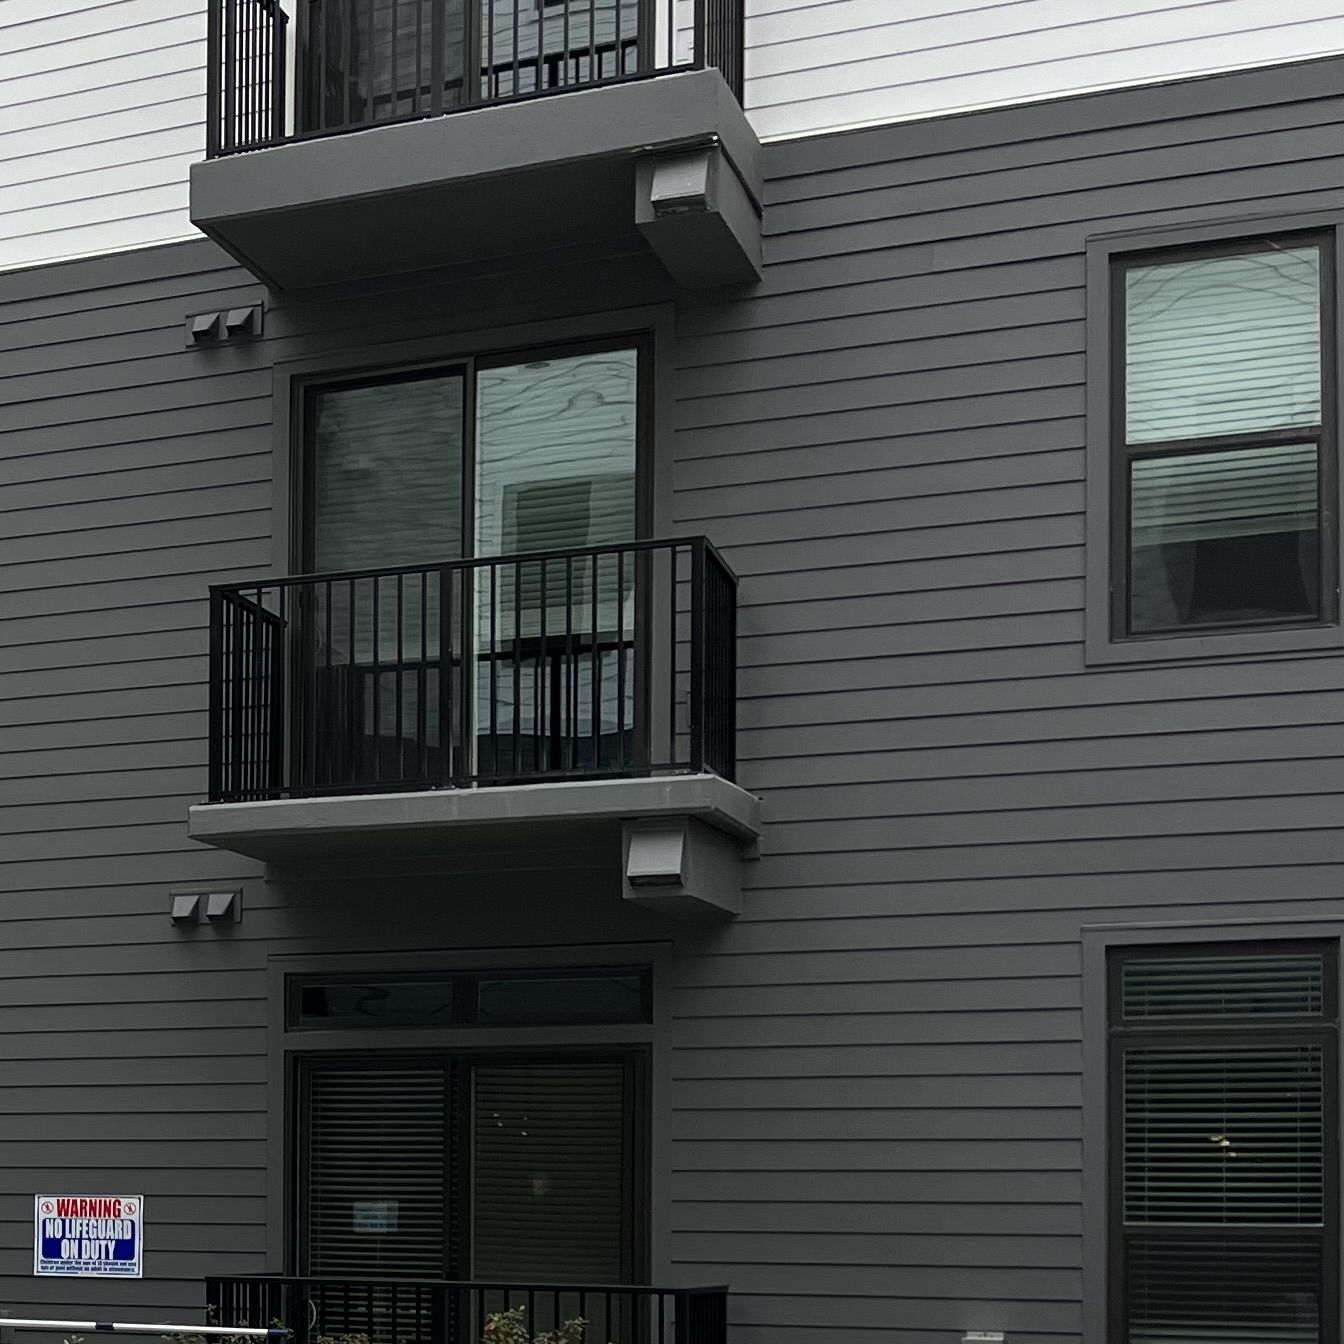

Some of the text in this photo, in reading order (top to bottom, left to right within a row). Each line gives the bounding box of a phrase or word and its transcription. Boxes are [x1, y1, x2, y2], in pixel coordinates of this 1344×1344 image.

[56, 1198, 122, 1218] WARNING
[45, 1218, 132, 1240] NO LIFEGUARD
[60, 1238, 116, 1260] ON DUTY
